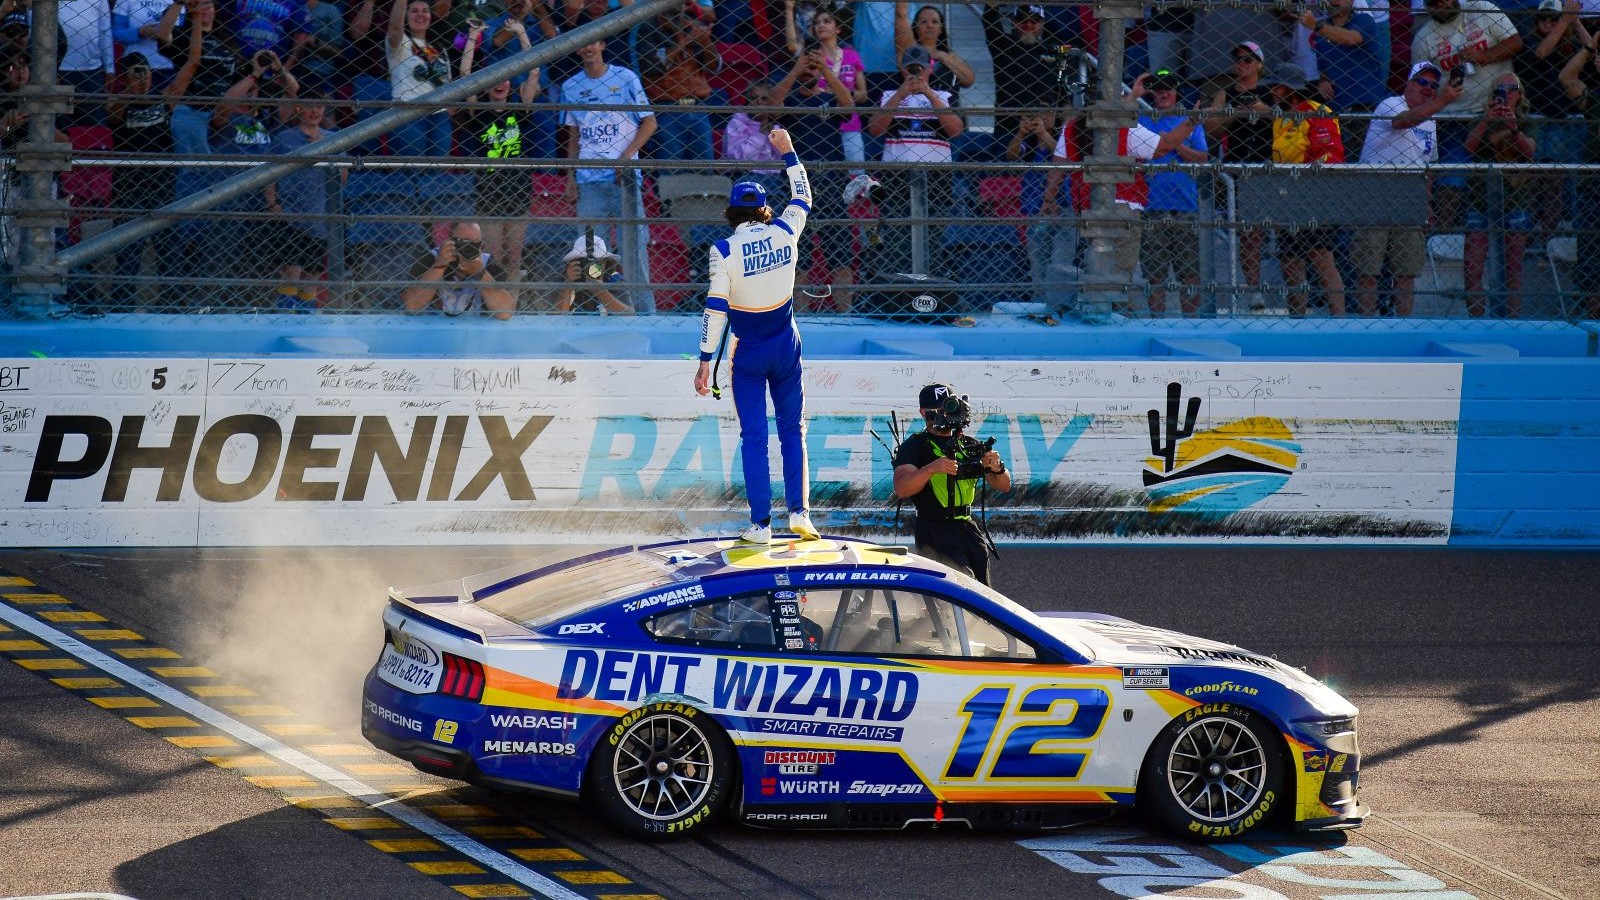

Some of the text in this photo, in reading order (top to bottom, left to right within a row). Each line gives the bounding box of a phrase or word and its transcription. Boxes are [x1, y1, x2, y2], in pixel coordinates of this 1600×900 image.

[742, 236, 773, 257] DENT
[743, 245, 791, 272] WIZARD
[702, 313, 711, 344] WIZARD
[151, 367, 168, 390] 5
[3, 407, 36, 424] BLANEY
[24, 414, 555, 502] PHOENIX
[804, 572, 909, 581] RYAN BLANEY
[639, 585, 703, 609] ADVANCE
[666, 592, 706, 607] AUTO PARTS
[558, 622, 606, 635] DEX
[404, 664, 434, 689] 82174
[1137, 668, 1162, 676] NASCAR
[556, 649, 920, 722] DENT WIZARD
[378, 705, 422, 732] RACING
[491, 714, 577, 730] WABASH
[1185, 703, 1231, 722] EAGLE
[432, 718, 458, 744] 12
[762, 719, 897, 739] SMART REPAIRS
[938, 683, 1113, 782] 12
[484, 740, 576, 755] MENARDS
[764, 751, 836, 765] DISCOUNT
[784, 765, 814, 773] TIRE
[847, 780, 923, 797] Snap-on
[667, 804, 711, 833] EAGLE
